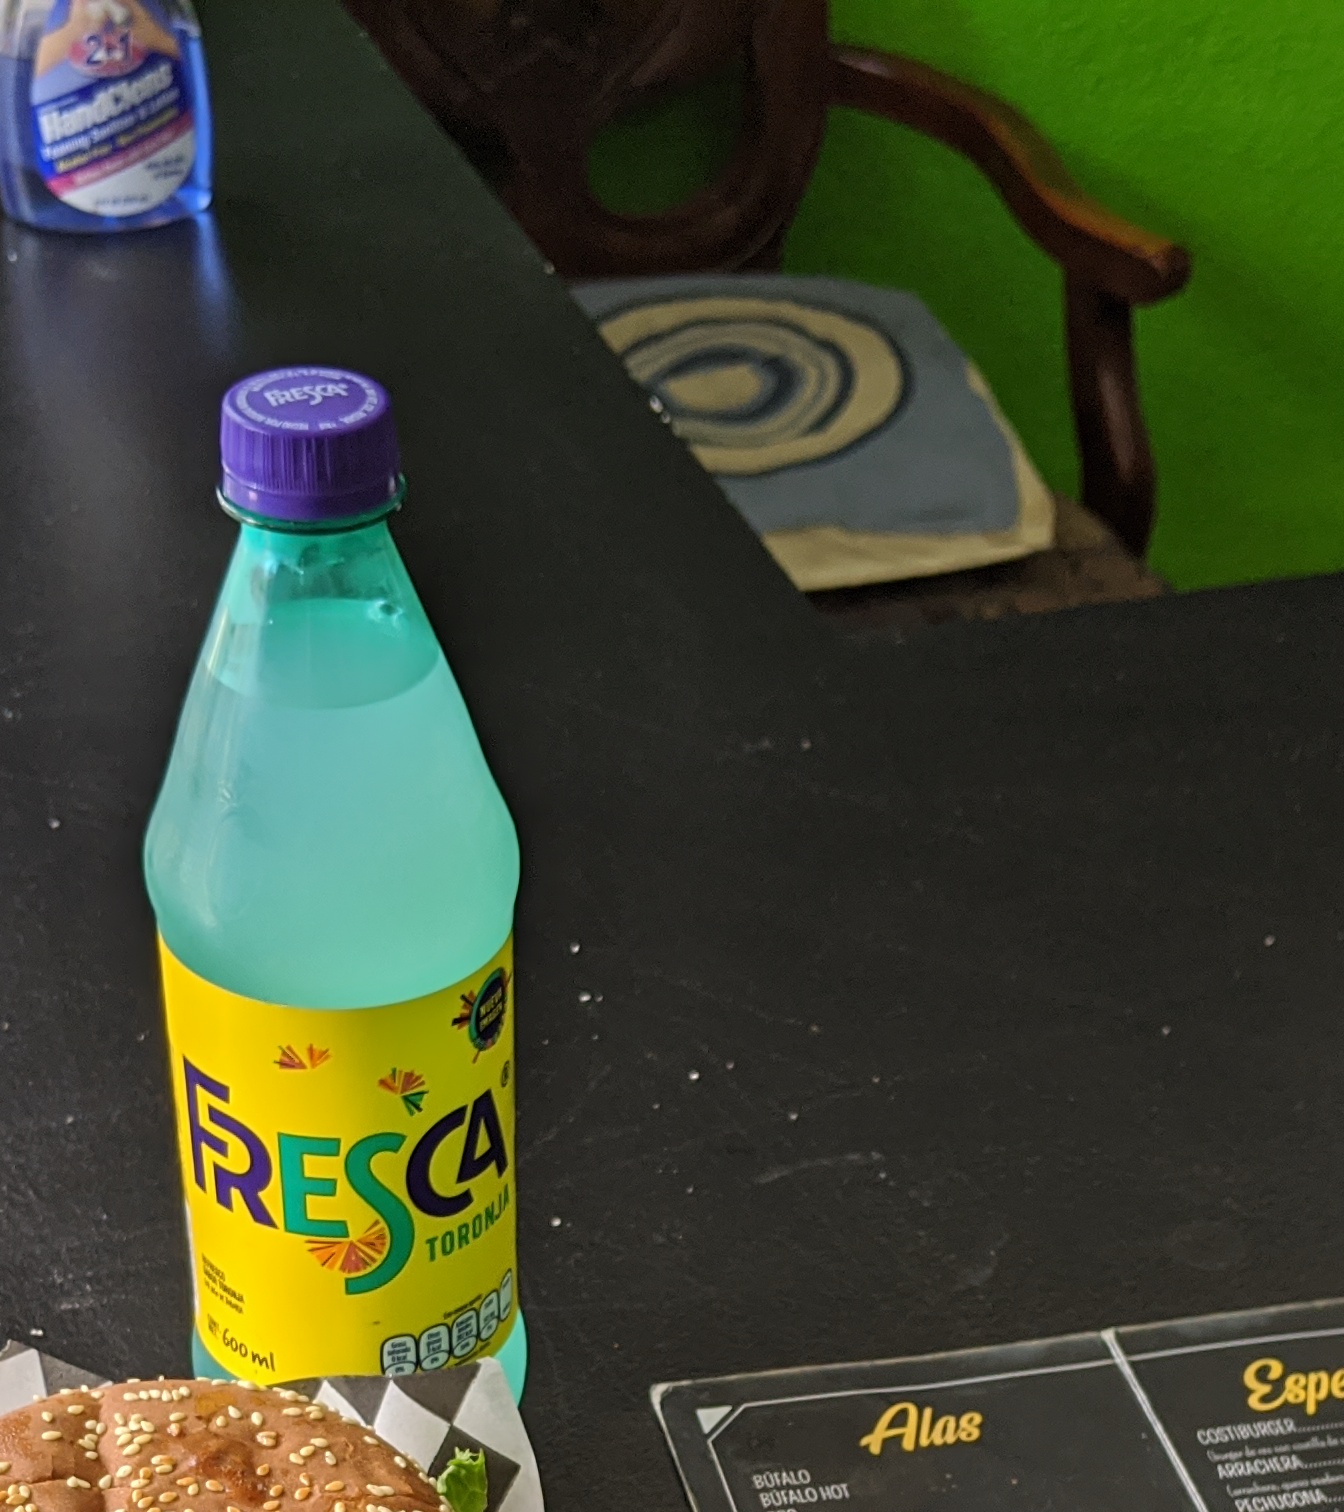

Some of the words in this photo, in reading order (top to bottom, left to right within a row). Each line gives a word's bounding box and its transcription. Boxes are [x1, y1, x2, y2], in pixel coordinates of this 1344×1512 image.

[264, 382, 348, 408] FRESCA
[182, 1054, 509, 1296] FRESCA
[425, 1182, 511, 1263] TORONJA
[222, 1326, 249, 1359] 600
[251, 1350, 277, 1373] ml
[858, 1400, 984, 1456] Alas
[1195, 1416, 1297, 1446] COSTIBURGER
[751, 1467, 811, 1490] BÚFALO
[1215, 1453, 1307, 1480] ARRACHERA
[758, 1486, 819, 1508] BÚFALO
[817, 1482, 850, 1501] HOT
